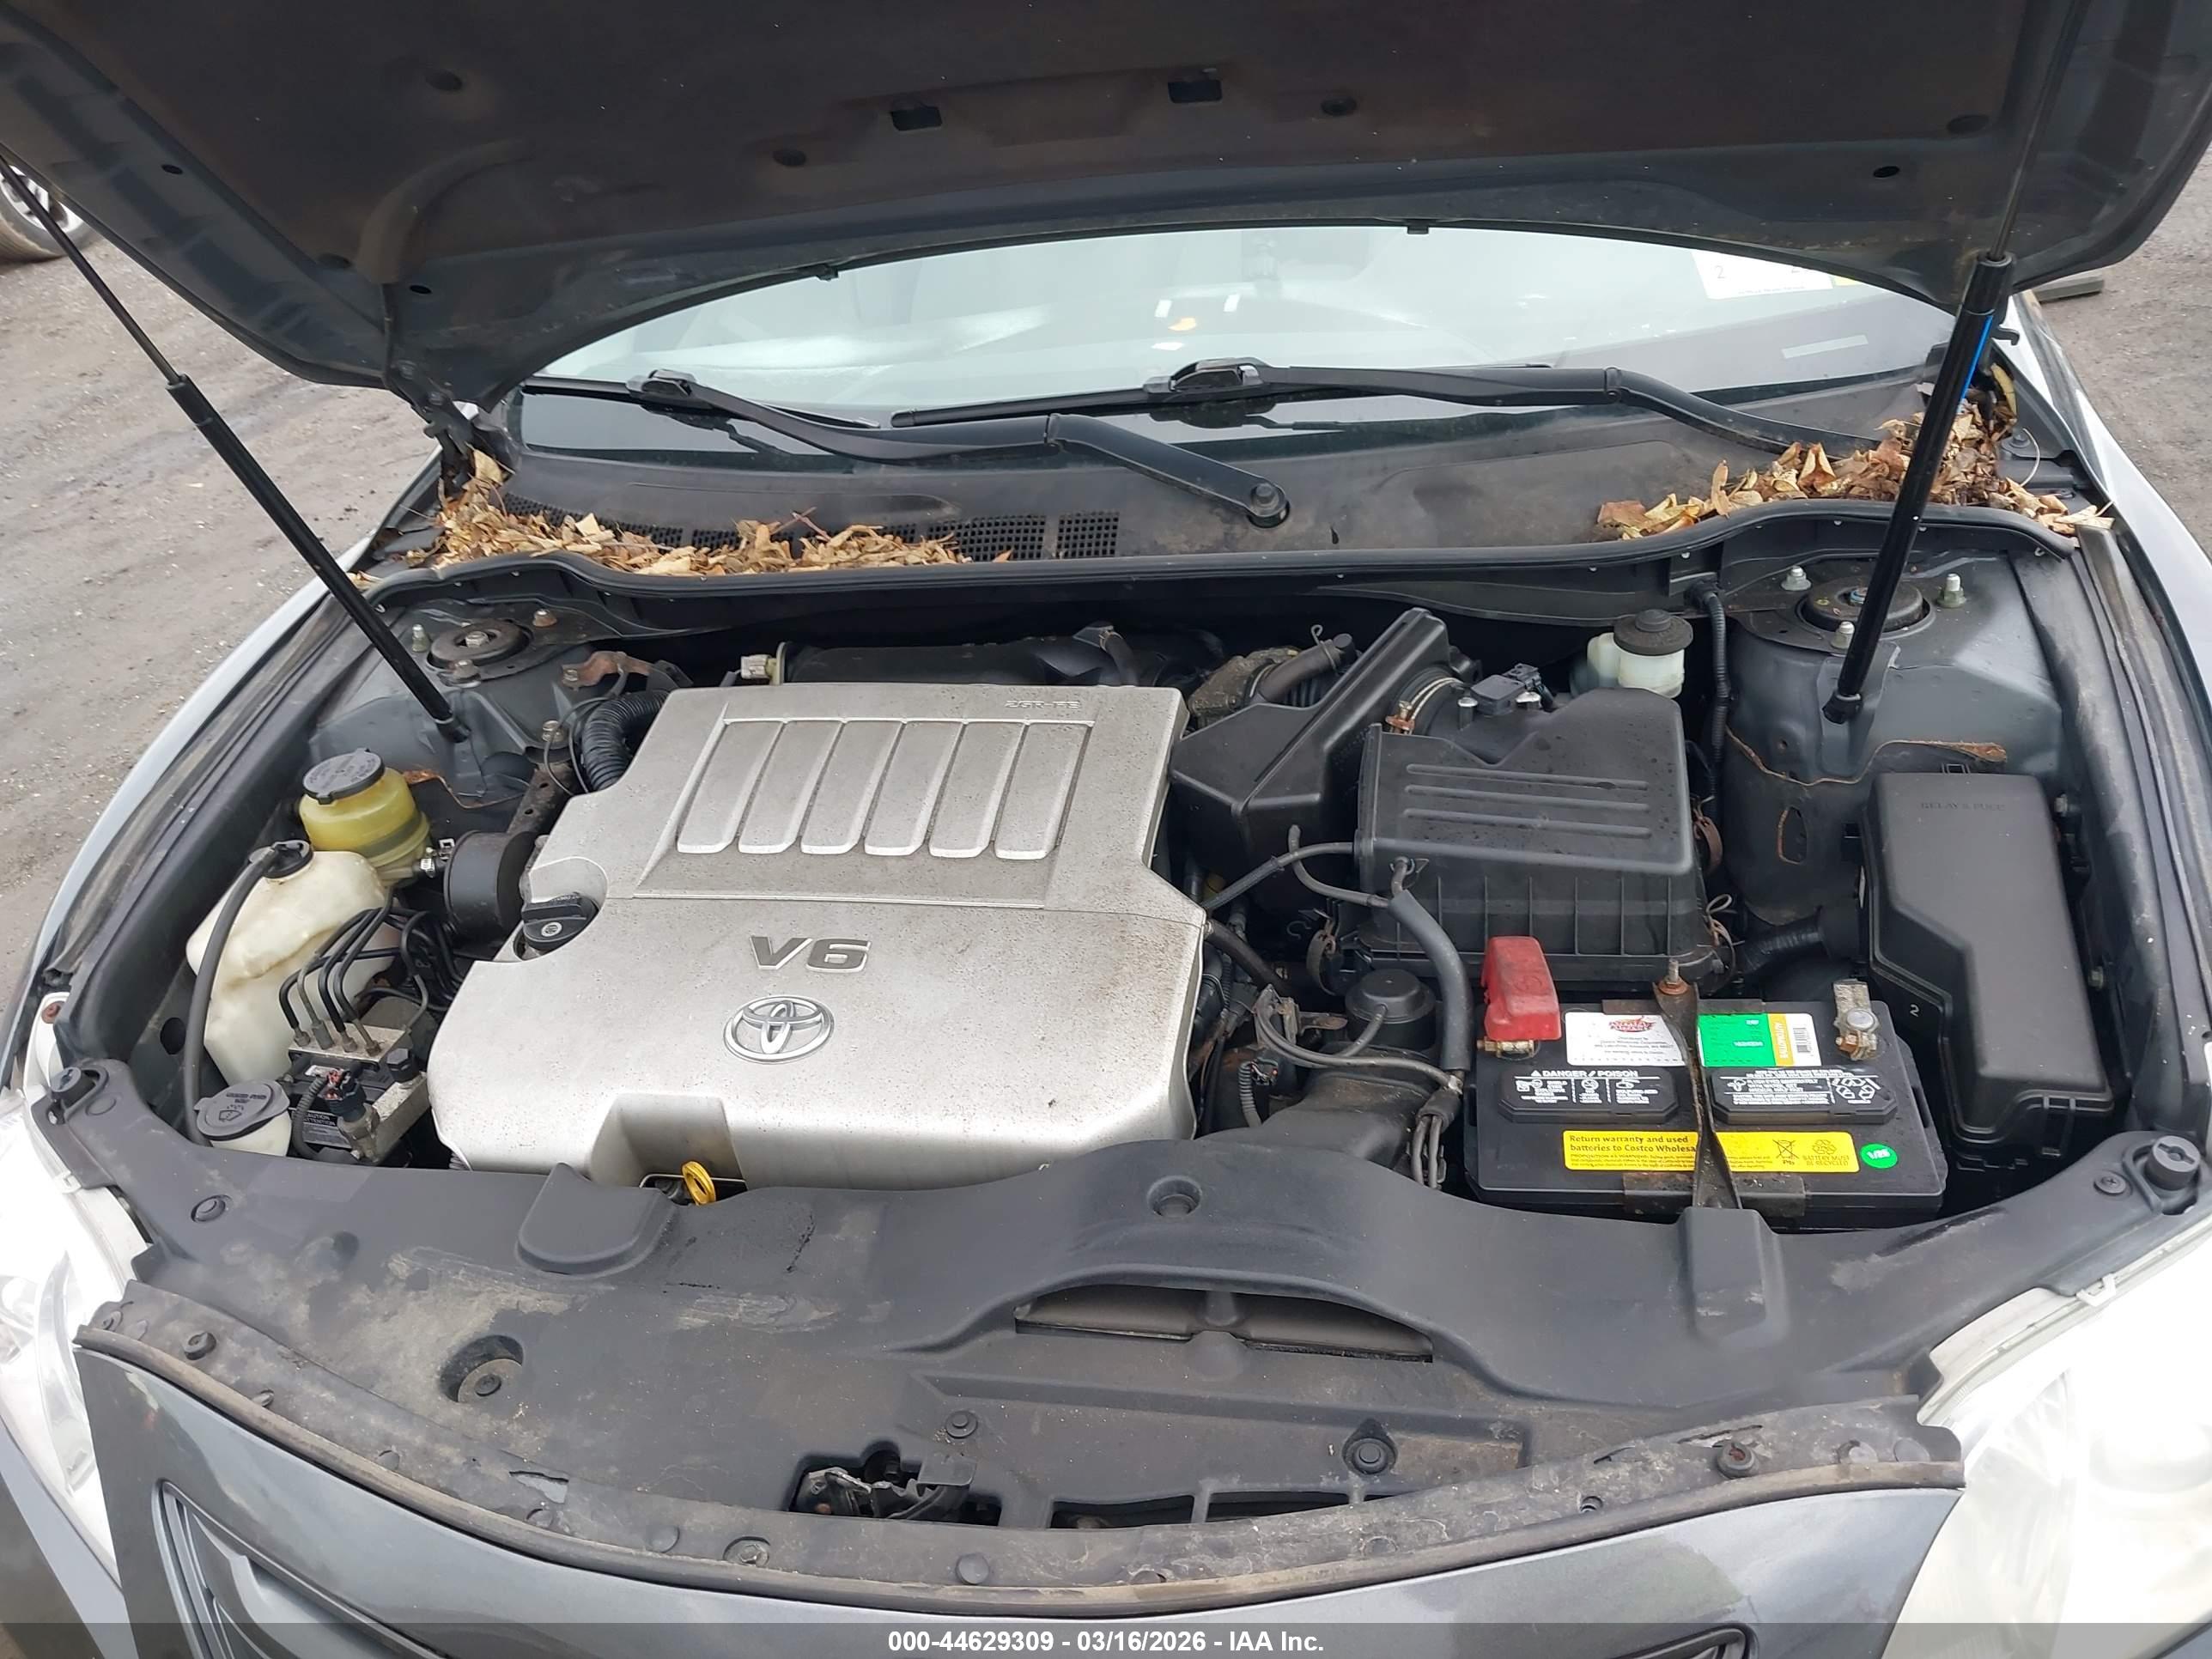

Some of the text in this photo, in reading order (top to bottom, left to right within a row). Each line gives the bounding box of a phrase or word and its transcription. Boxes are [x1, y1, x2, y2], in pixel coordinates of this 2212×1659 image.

[750, 936, 872, 973] V6
[1910, 1004, 1920, 1018] 2
[1603, 1135, 1644, 1145] warranty
